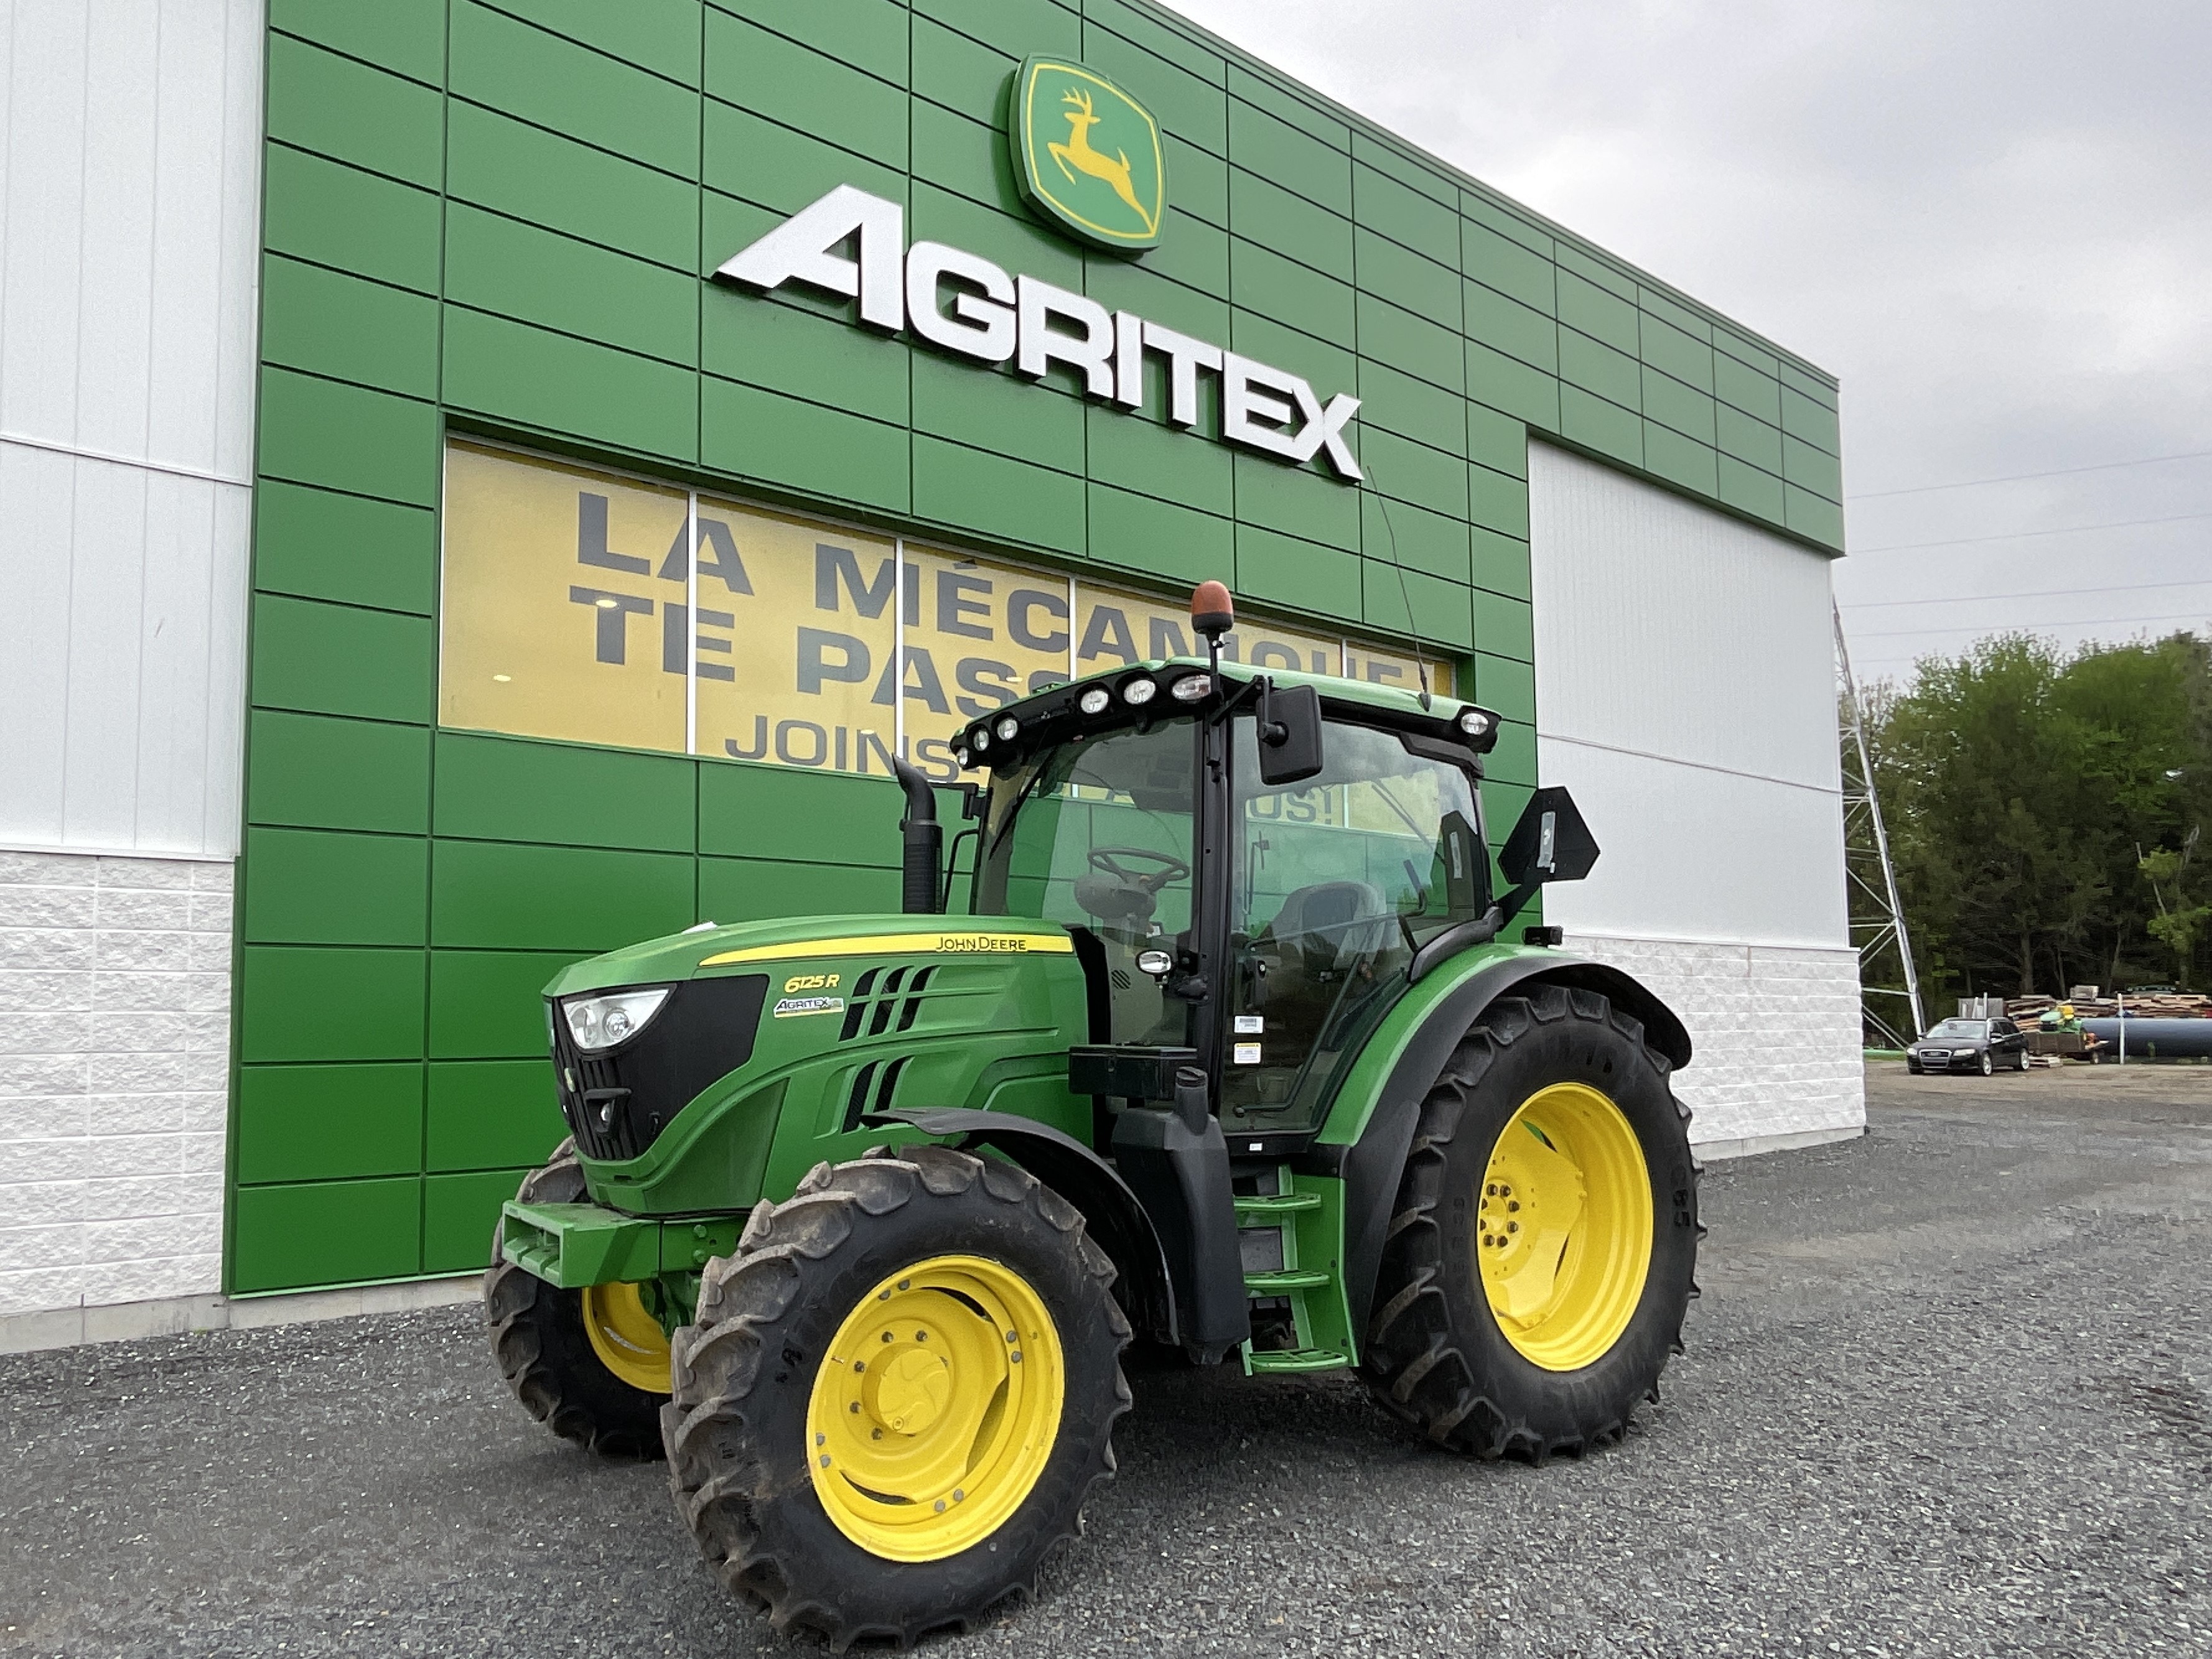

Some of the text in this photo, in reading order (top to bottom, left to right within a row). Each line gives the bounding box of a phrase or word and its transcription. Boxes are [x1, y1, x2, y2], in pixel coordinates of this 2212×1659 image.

[715, 183, 1363, 481] AGRITEX
[578, 491, 755, 596] LA
[569, 585, 735, 682] TE
